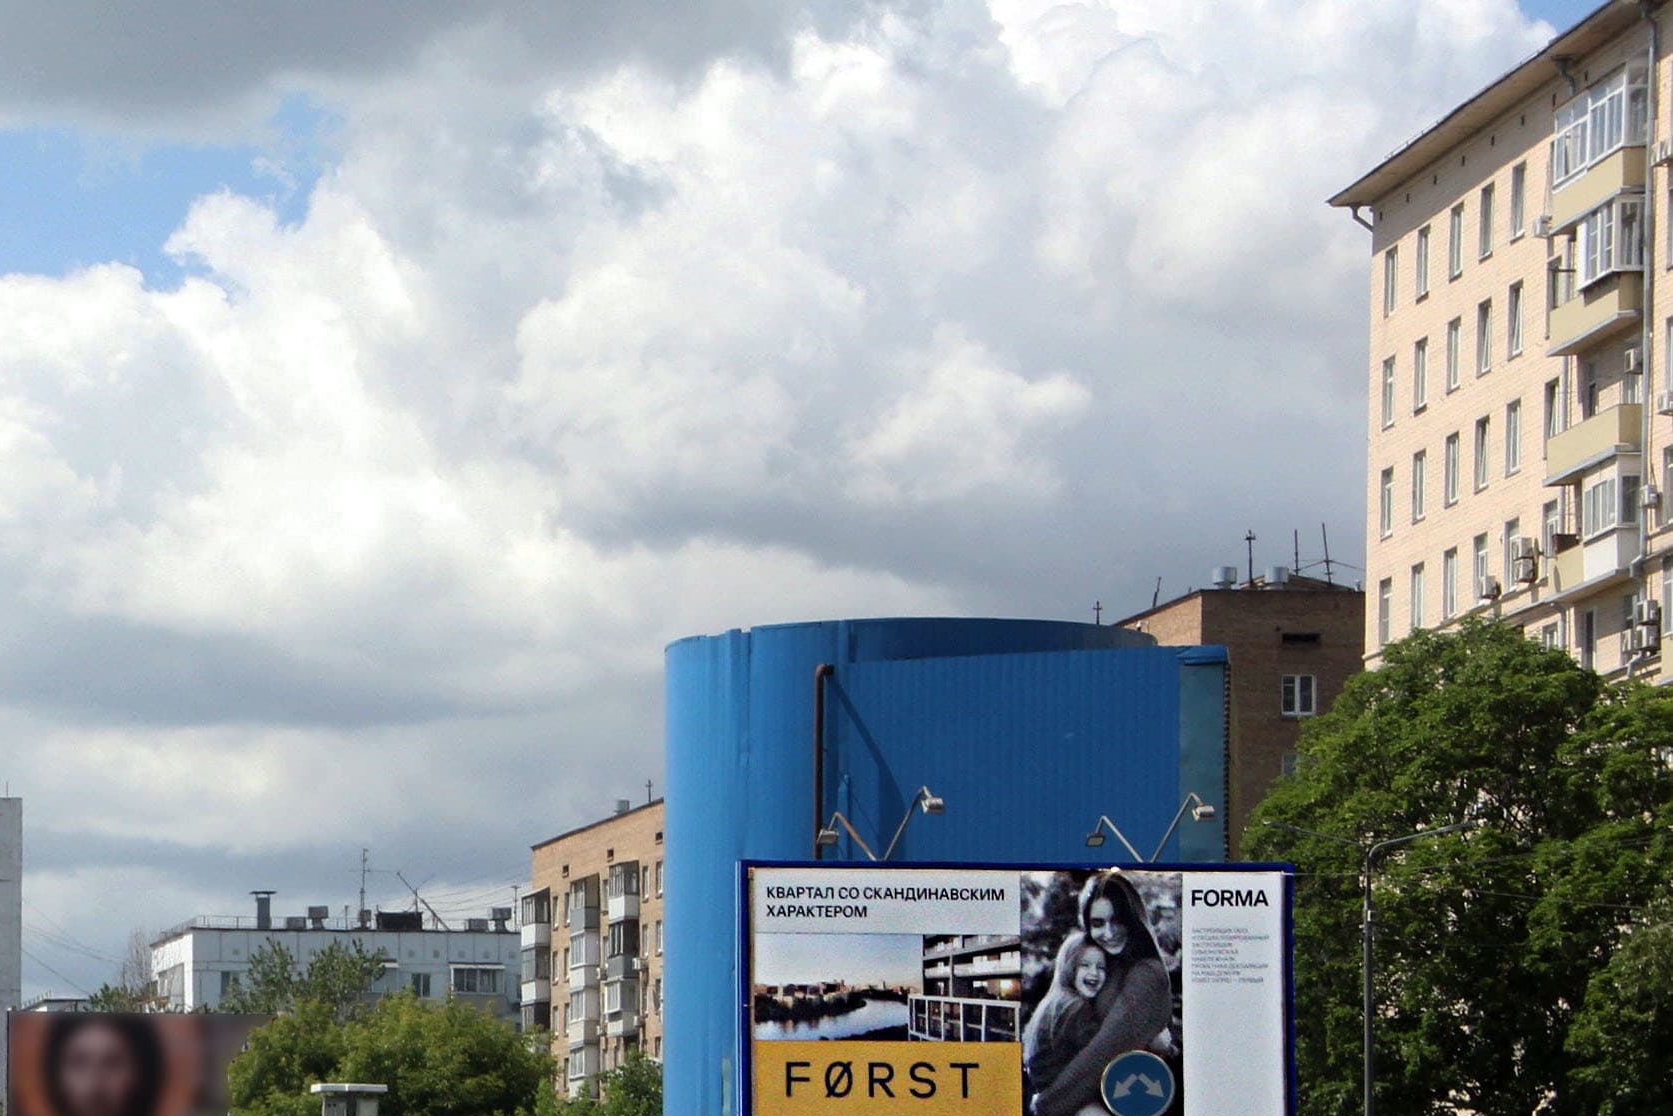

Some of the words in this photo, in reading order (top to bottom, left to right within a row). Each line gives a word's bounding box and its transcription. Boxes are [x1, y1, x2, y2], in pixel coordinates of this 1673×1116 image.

[766, 886, 834, 899] КВАРТАЛ
[838, 887, 860, 900] СО
[863, 887, 1005, 902] СКАНДИНАВСКИМ
[1191, 889, 1269, 907] FORMA
[766, 905, 868, 918] ХАРАКТЕРОМ
[785, 1060, 980, 1099] FØRST
